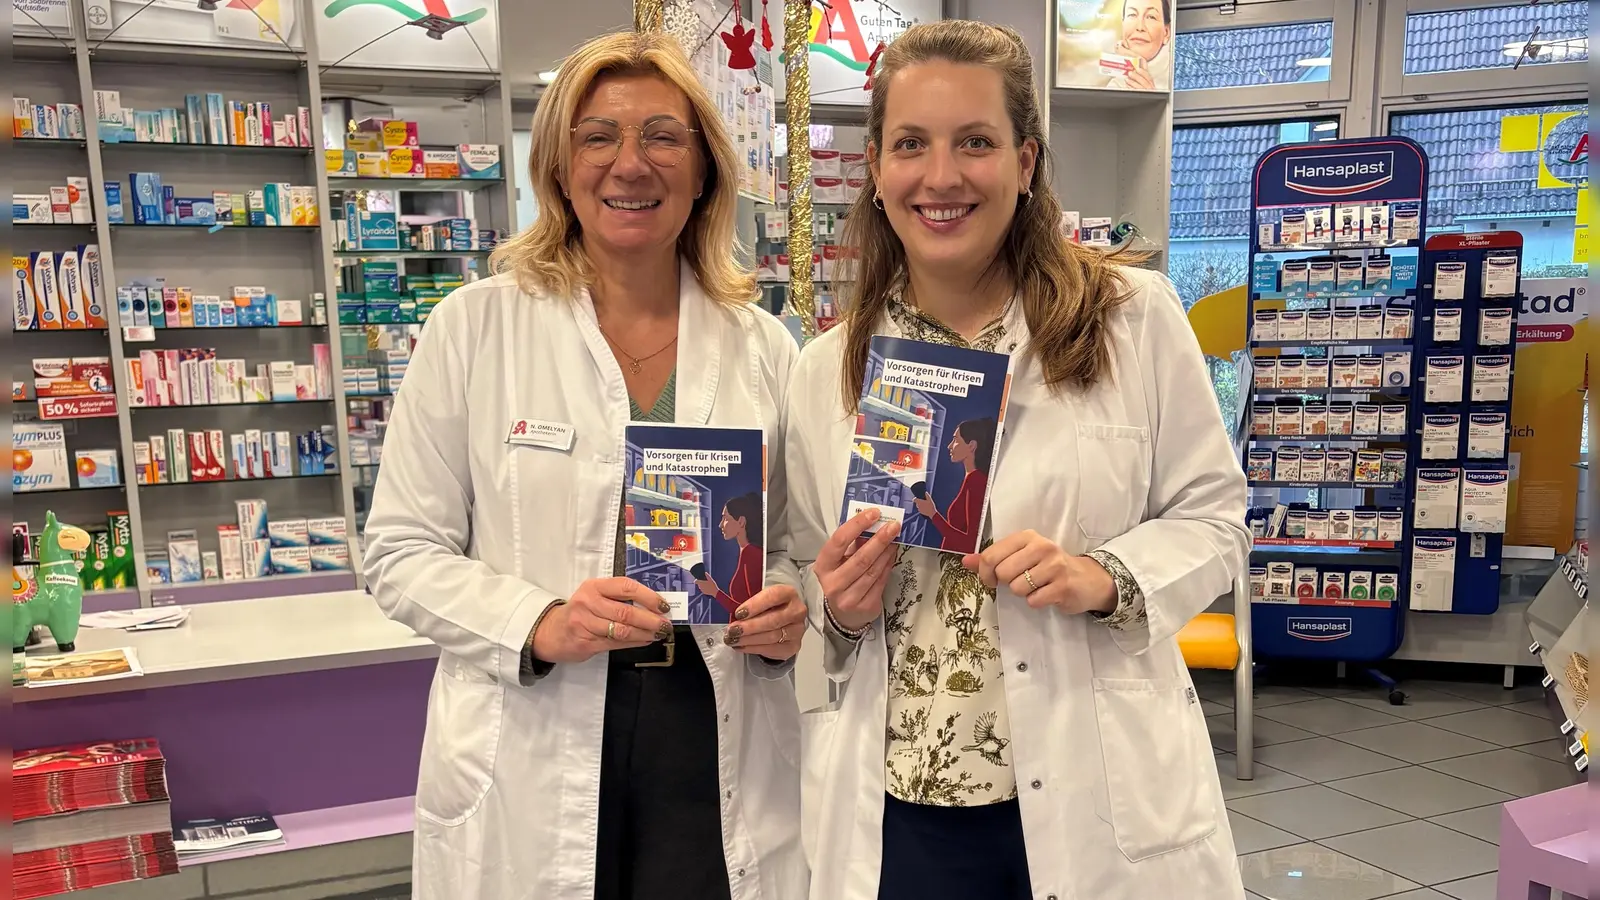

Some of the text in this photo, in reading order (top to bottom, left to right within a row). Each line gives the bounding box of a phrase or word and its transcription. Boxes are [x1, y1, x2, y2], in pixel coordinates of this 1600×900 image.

[860, 16, 892, 27] Guten
[1294, 161, 1384, 179] Hansaplast
[362, 227, 395, 235] Lyranda
[886, 360, 981, 383] Vorsorgen für Krisen
[884, 375, 966, 394] und Katastrophen
[538, 425, 566, 433] OMELYAN
[646, 450, 739, 462] Vorsorgen für Krisen
[646, 463, 726, 474] und Katastrophen
[116, 516, 130, 545] Kytta
[96, 533, 109, 559] Kytta
[1292, 622, 1346, 632] Hansaplast
